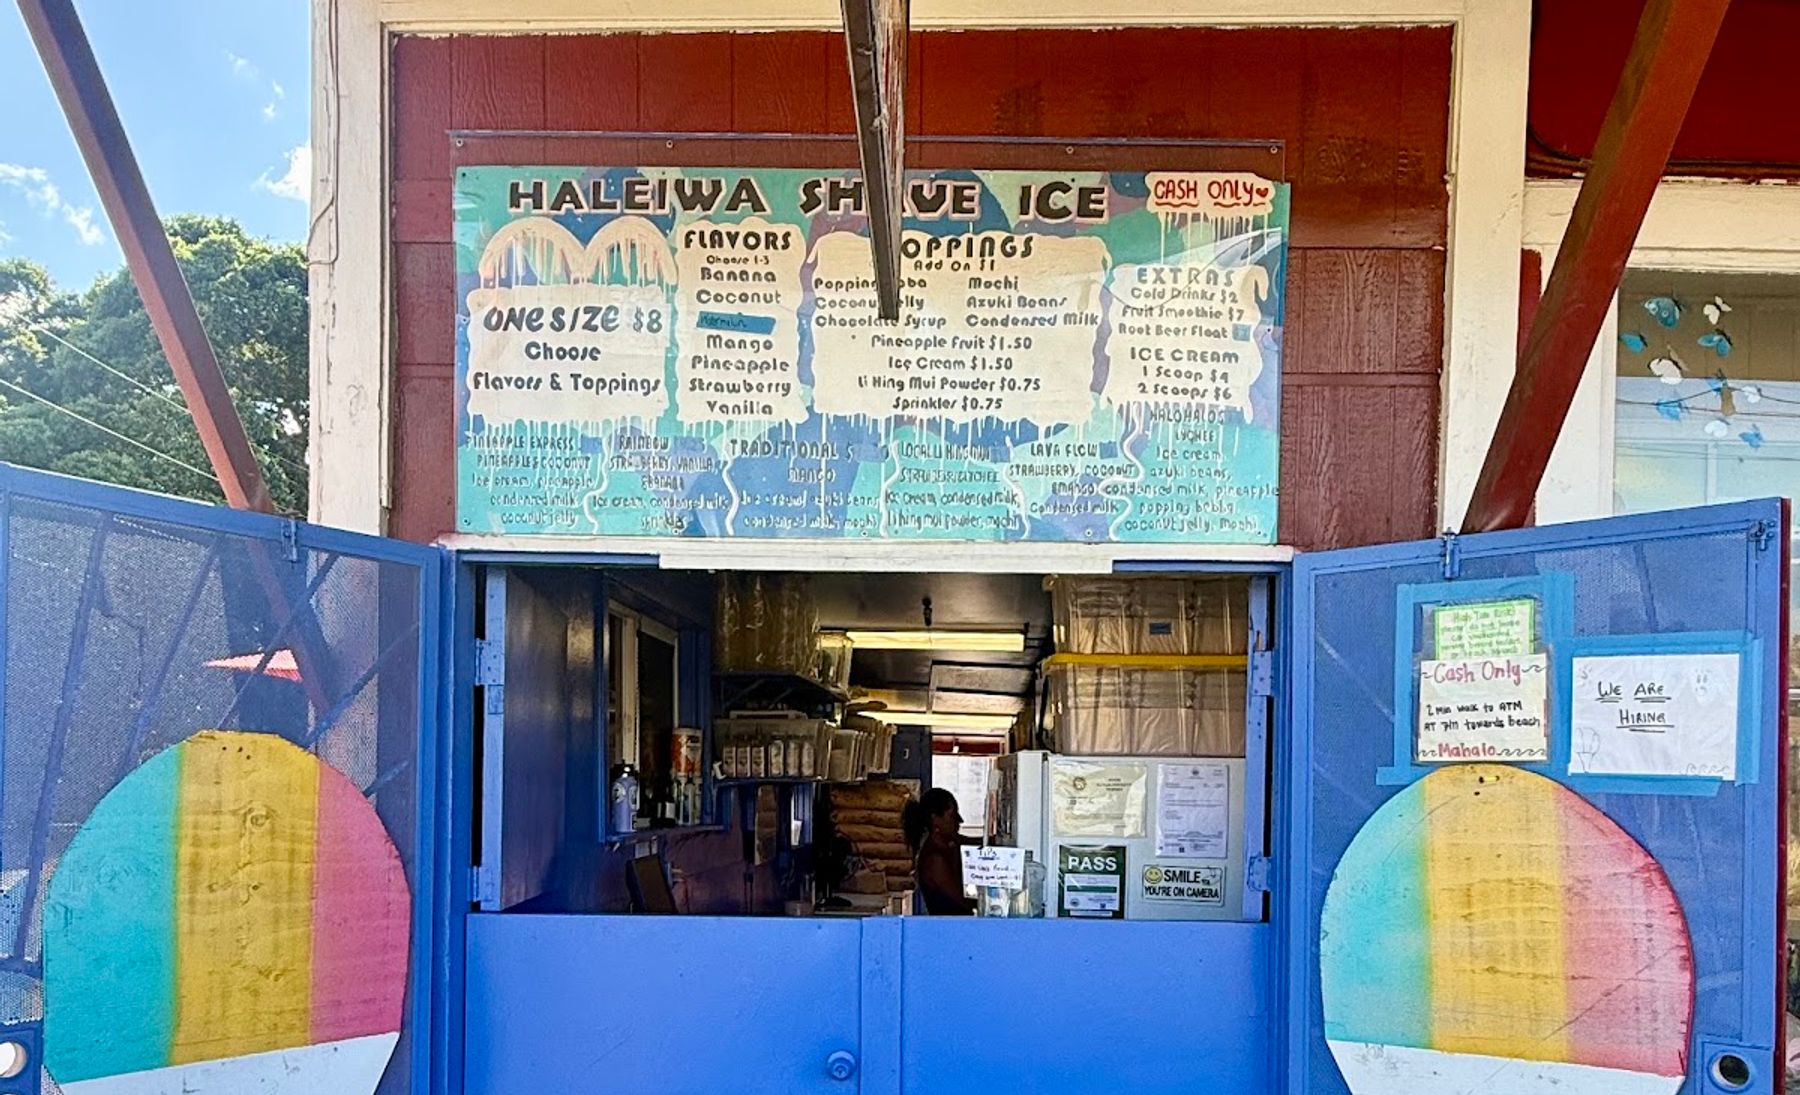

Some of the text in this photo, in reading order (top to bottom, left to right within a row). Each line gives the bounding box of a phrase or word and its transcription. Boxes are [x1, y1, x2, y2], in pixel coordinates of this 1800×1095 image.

[509, 178, 1106, 219] HALEIWA SHVE ICE
[1154, 179, 1254, 206] CASH ONLY
[684, 229, 792, 251] FLAVORS
[900, 235, 1034, 259] OPPINGS
[706, 254, 770, 265] Choose 1-3
[913, 259, 944, 272] Add
[950, 263, 970, 272] On
[700, 266, 777, 282] Banana
[968, 275, 1019, 290] Mochi
[1137, 267, 1236, 288] EXTRAS
[696, 289, 782, 305] Coconut
[814, 296, 877, 310] Coconu
[966, 295, 1068, 309] Azuki Beans
[1131, 286, 1239, 305] Cold Drinks $2
[549, 305, 621, 334] SIZE
[632, 306, 663, 335] $8
[965, 312, 1100, 328] Condensed Milk
[1121, 303, 1245, 322] Fruit Smoothie $7
[903, 313, 948, 330] Syrup
[1118, 322, 1151, 336] Root
[1155, 323, 1188, 337] Beer
[1190, 324, 1229, 339] Float
[706, 334, 774, 354] Mango
[871, 334, 1033, 350] Pineapple Fruit $1.50
[524, 341, 601, 361] Choose
[1130, 346, 1240, 363] ICE CREAM
[691, 354, 790, 374] Pineapple
[888, 355, 1014, 371] Ice Cream $1.50
[1143, 365, 1229, 384] 1 Scoop $4
[473, 372, 662, 397] Flavors & Toppings
[688, 377, 792, 397] Strawberry
[858, 374, 1042, 393] Li Hing Mui Powder $0.75
[1137, 382, 1232, 401] 2 Scoops $6
[706, 399, 774, 416] Vanilla
[892, 395, 1003, 412] Sprinkles $0.75
[530, 436, 574, 451] EXPRESS
[619, 434, 669, 451] RAINBOW
[730, 438, 840, 459] TRADITIONAL
[1031, 442, 1098, 458] LAVA FLOW
[1156, 446, 1179, 460] Ice
[1084, 463, 1137, 477] COCONUT
[1433, 659, 1522, 687] Cash Only
[1484, 702, 1494, 713] to
[1500, 700, 1523, 712] ATM
[1424, 722, 1437, 732] AT
[1464, 716, 1505, 731] towards
[1508, 715, 1541, 729] beach
[1438, 742, 1496, 757] Mahalo
[1067, 855, 1118, 872] PASS
[1163, 869, 1202, 884] SMILE
[1144, 886, 1220, 899] YOU'RE ON CAMERA
